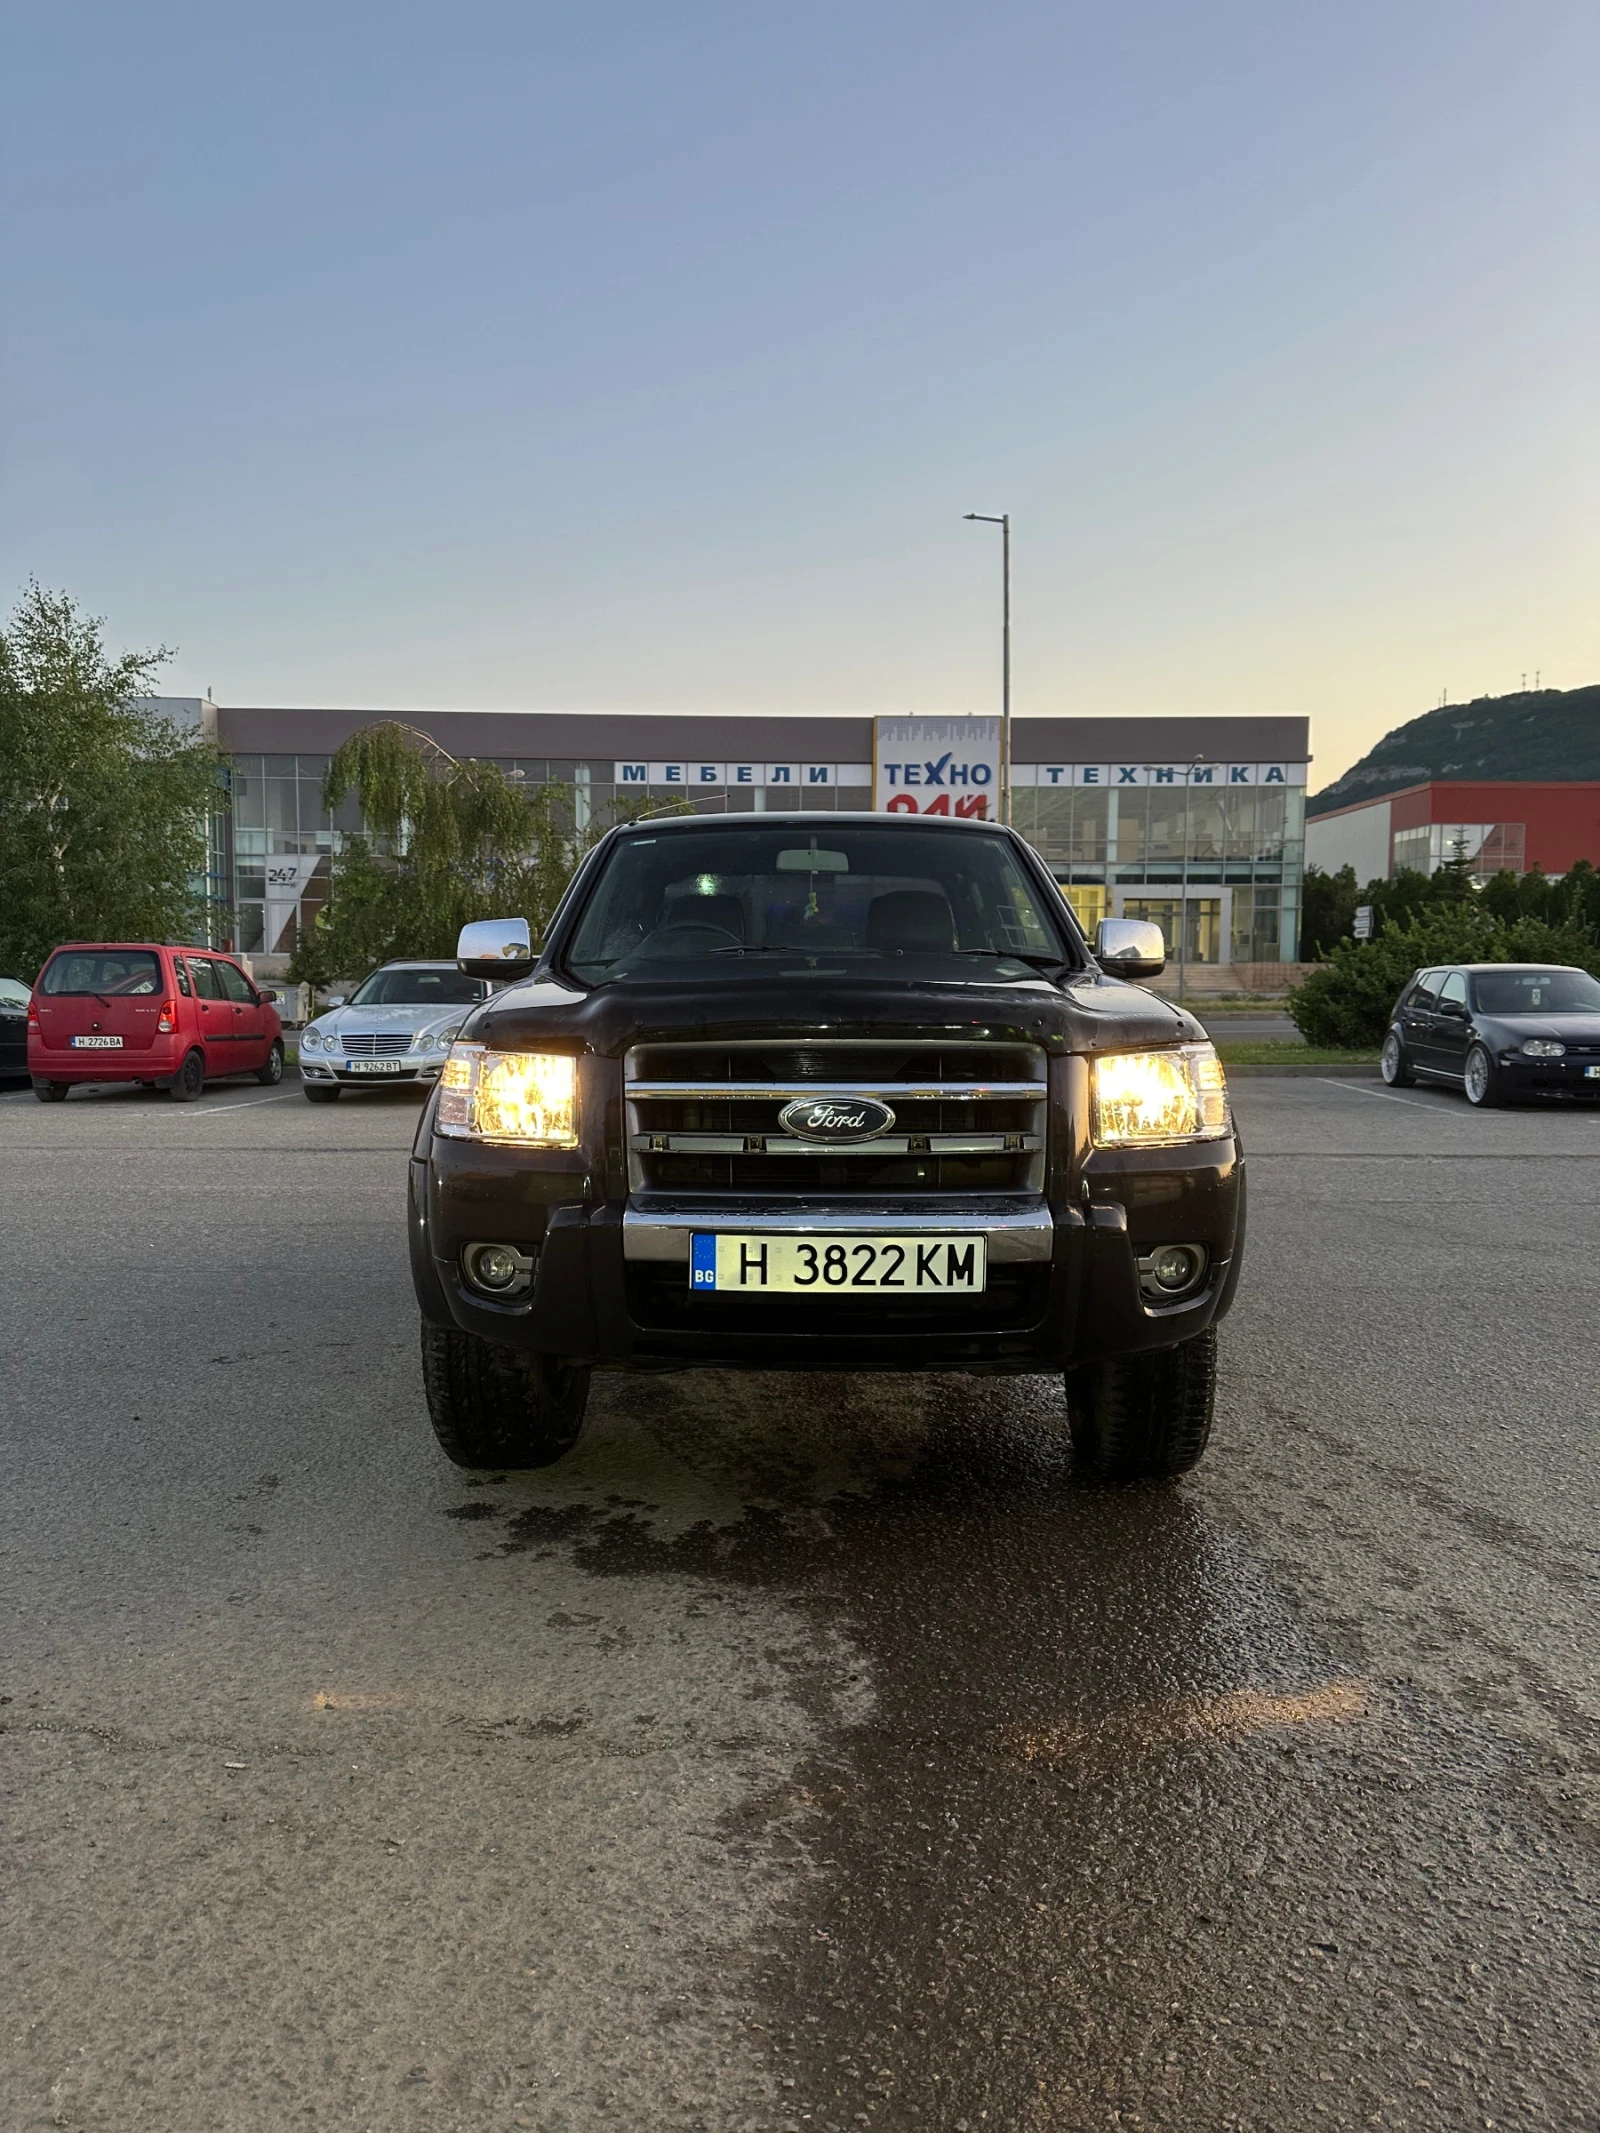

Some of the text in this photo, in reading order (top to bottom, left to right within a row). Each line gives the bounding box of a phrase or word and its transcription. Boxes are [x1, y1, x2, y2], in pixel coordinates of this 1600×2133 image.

[622, 765, 828, 783] МЕБЕЛИ
[884, 752, 991, 785] ТЕХНО
[1047, 767, 1285, 783] ТЕХНИКА
[807, 1104, 866, 1128] Ford
[740, 1243, 768, 1285] H
[695, 1270, 714, 1283] BG
